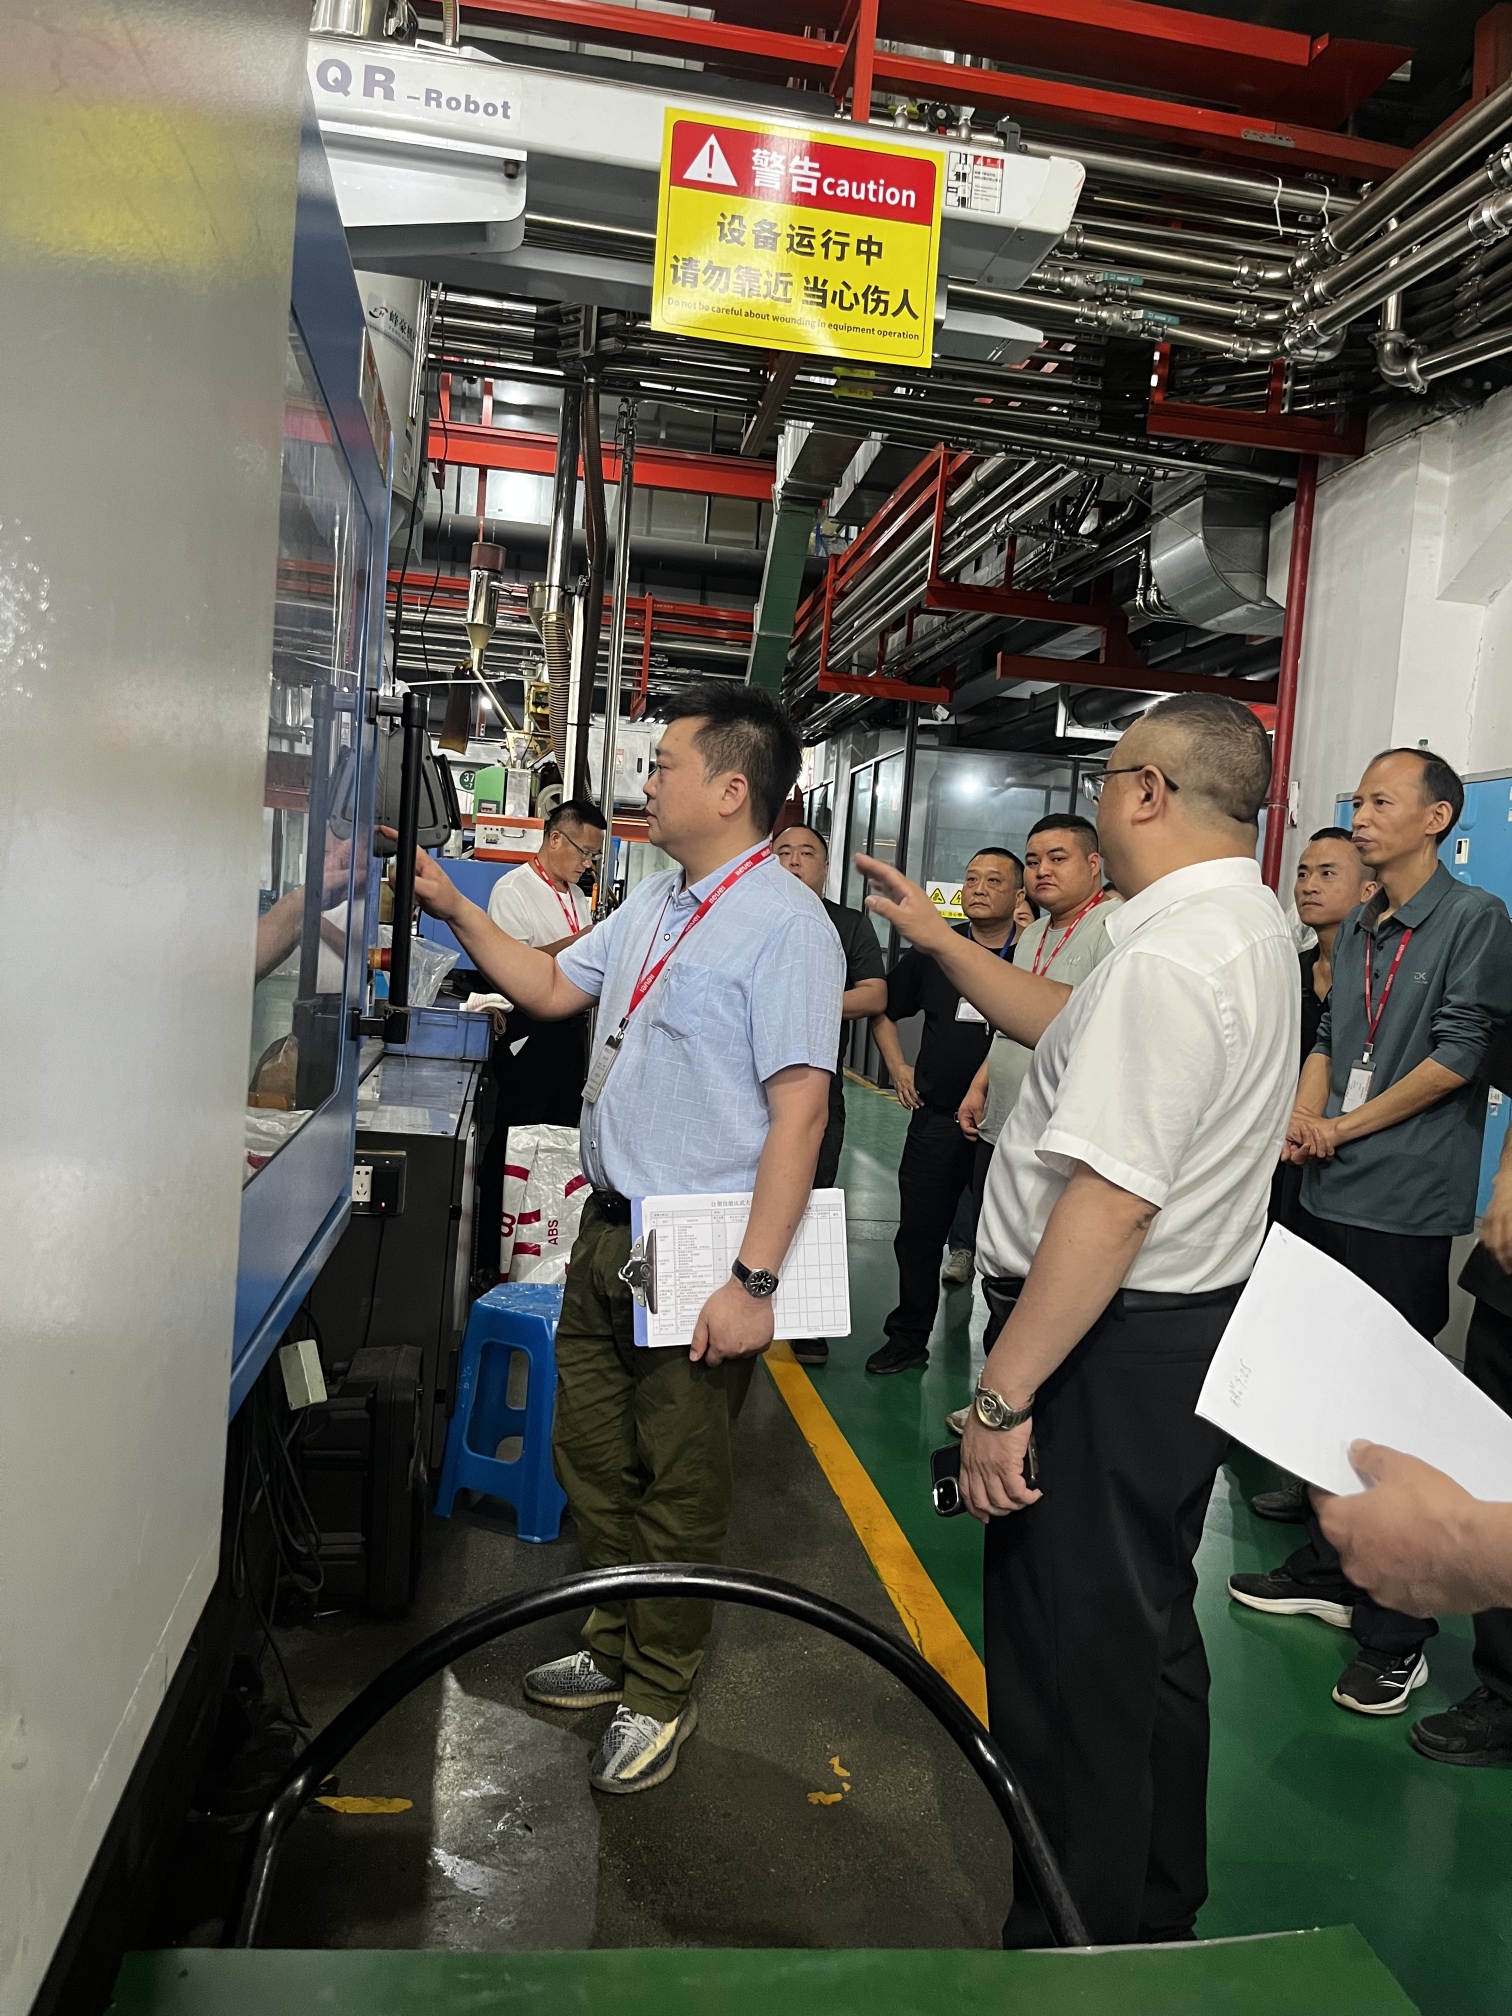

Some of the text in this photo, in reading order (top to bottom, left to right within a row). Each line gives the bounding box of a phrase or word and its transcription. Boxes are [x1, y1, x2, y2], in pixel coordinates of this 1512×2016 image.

[752, 148, 821, 196] 警告
[822, 177, 916, 208] caution
[716, 211, 884, 267] 设备运行中
[670, 254, 920, 321] 请勿靠近 当心伤人
[667, 296, 920, 341] Do not be careful about wounding in equipment operation
[548, 1219, 559, 1246] ABS
